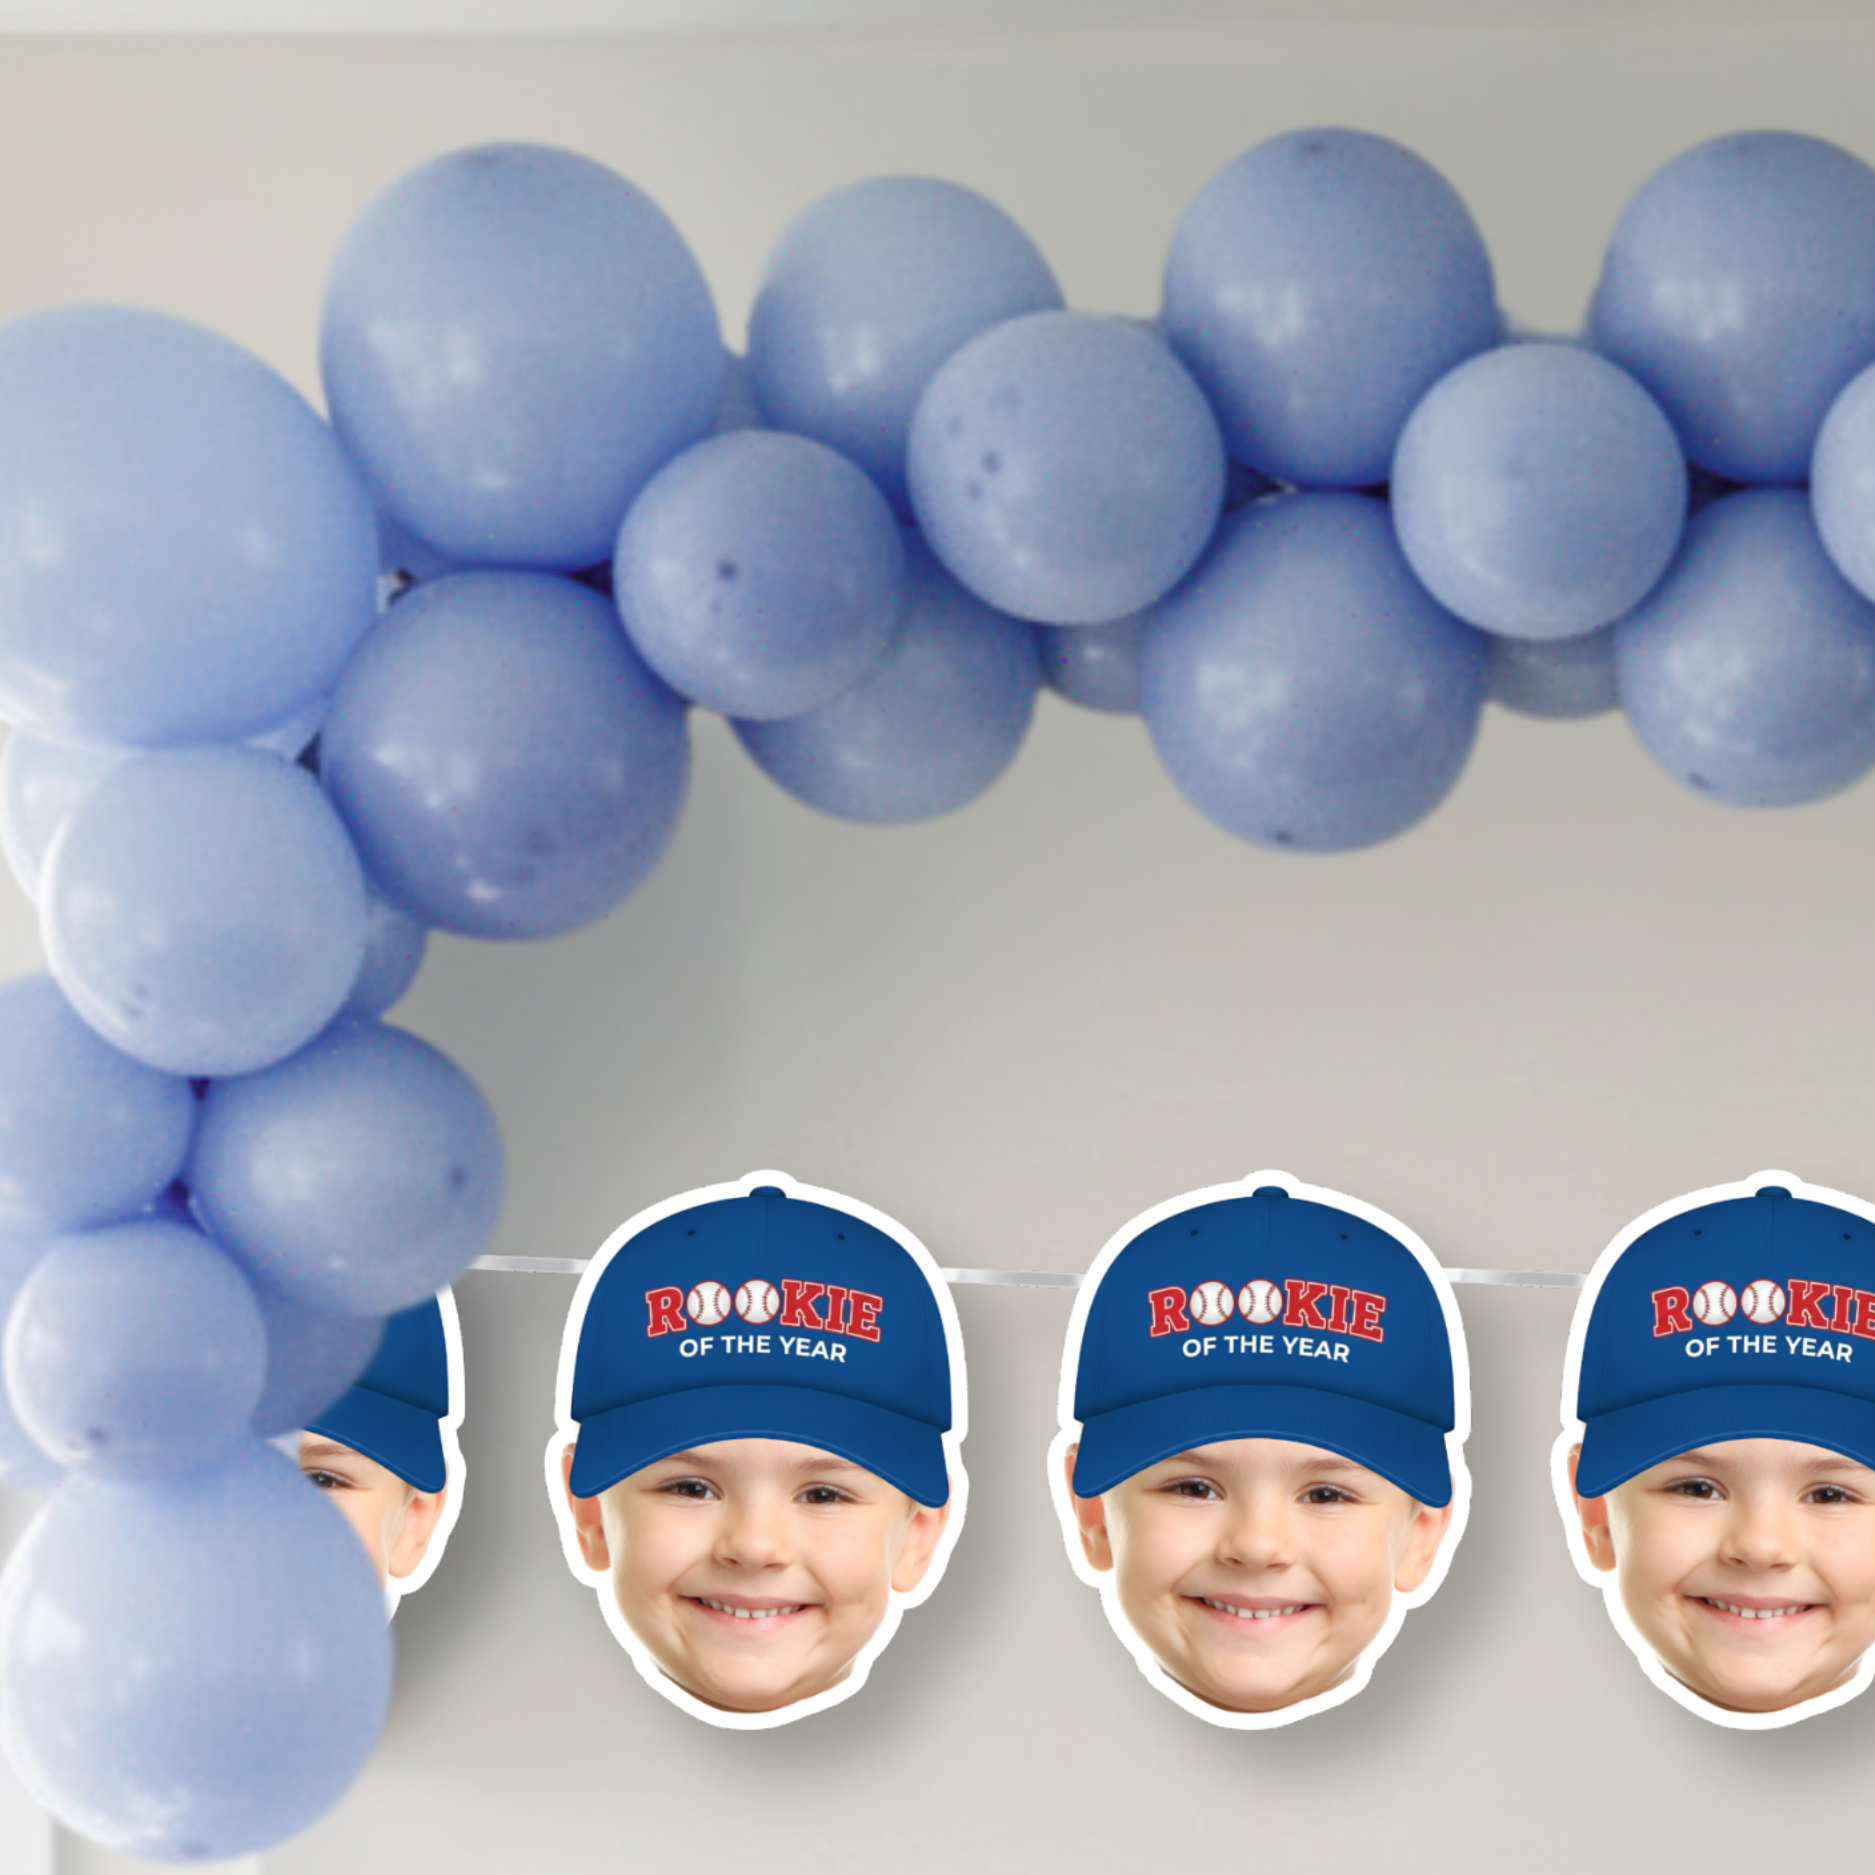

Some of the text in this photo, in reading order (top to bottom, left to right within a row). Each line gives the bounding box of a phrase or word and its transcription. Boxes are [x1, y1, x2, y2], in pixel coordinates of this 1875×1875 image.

[644, 1278, 884, 1344] ROOKIE
[1147, 1278, 1387, 1344] ROOKIE
[679, 1334, 847, 1363] OF THE YEAR
[1182, 1334, 1350, 1363] OF THE YEAR
[1685, 1334, 1853, 1363] OF THE YEAR
